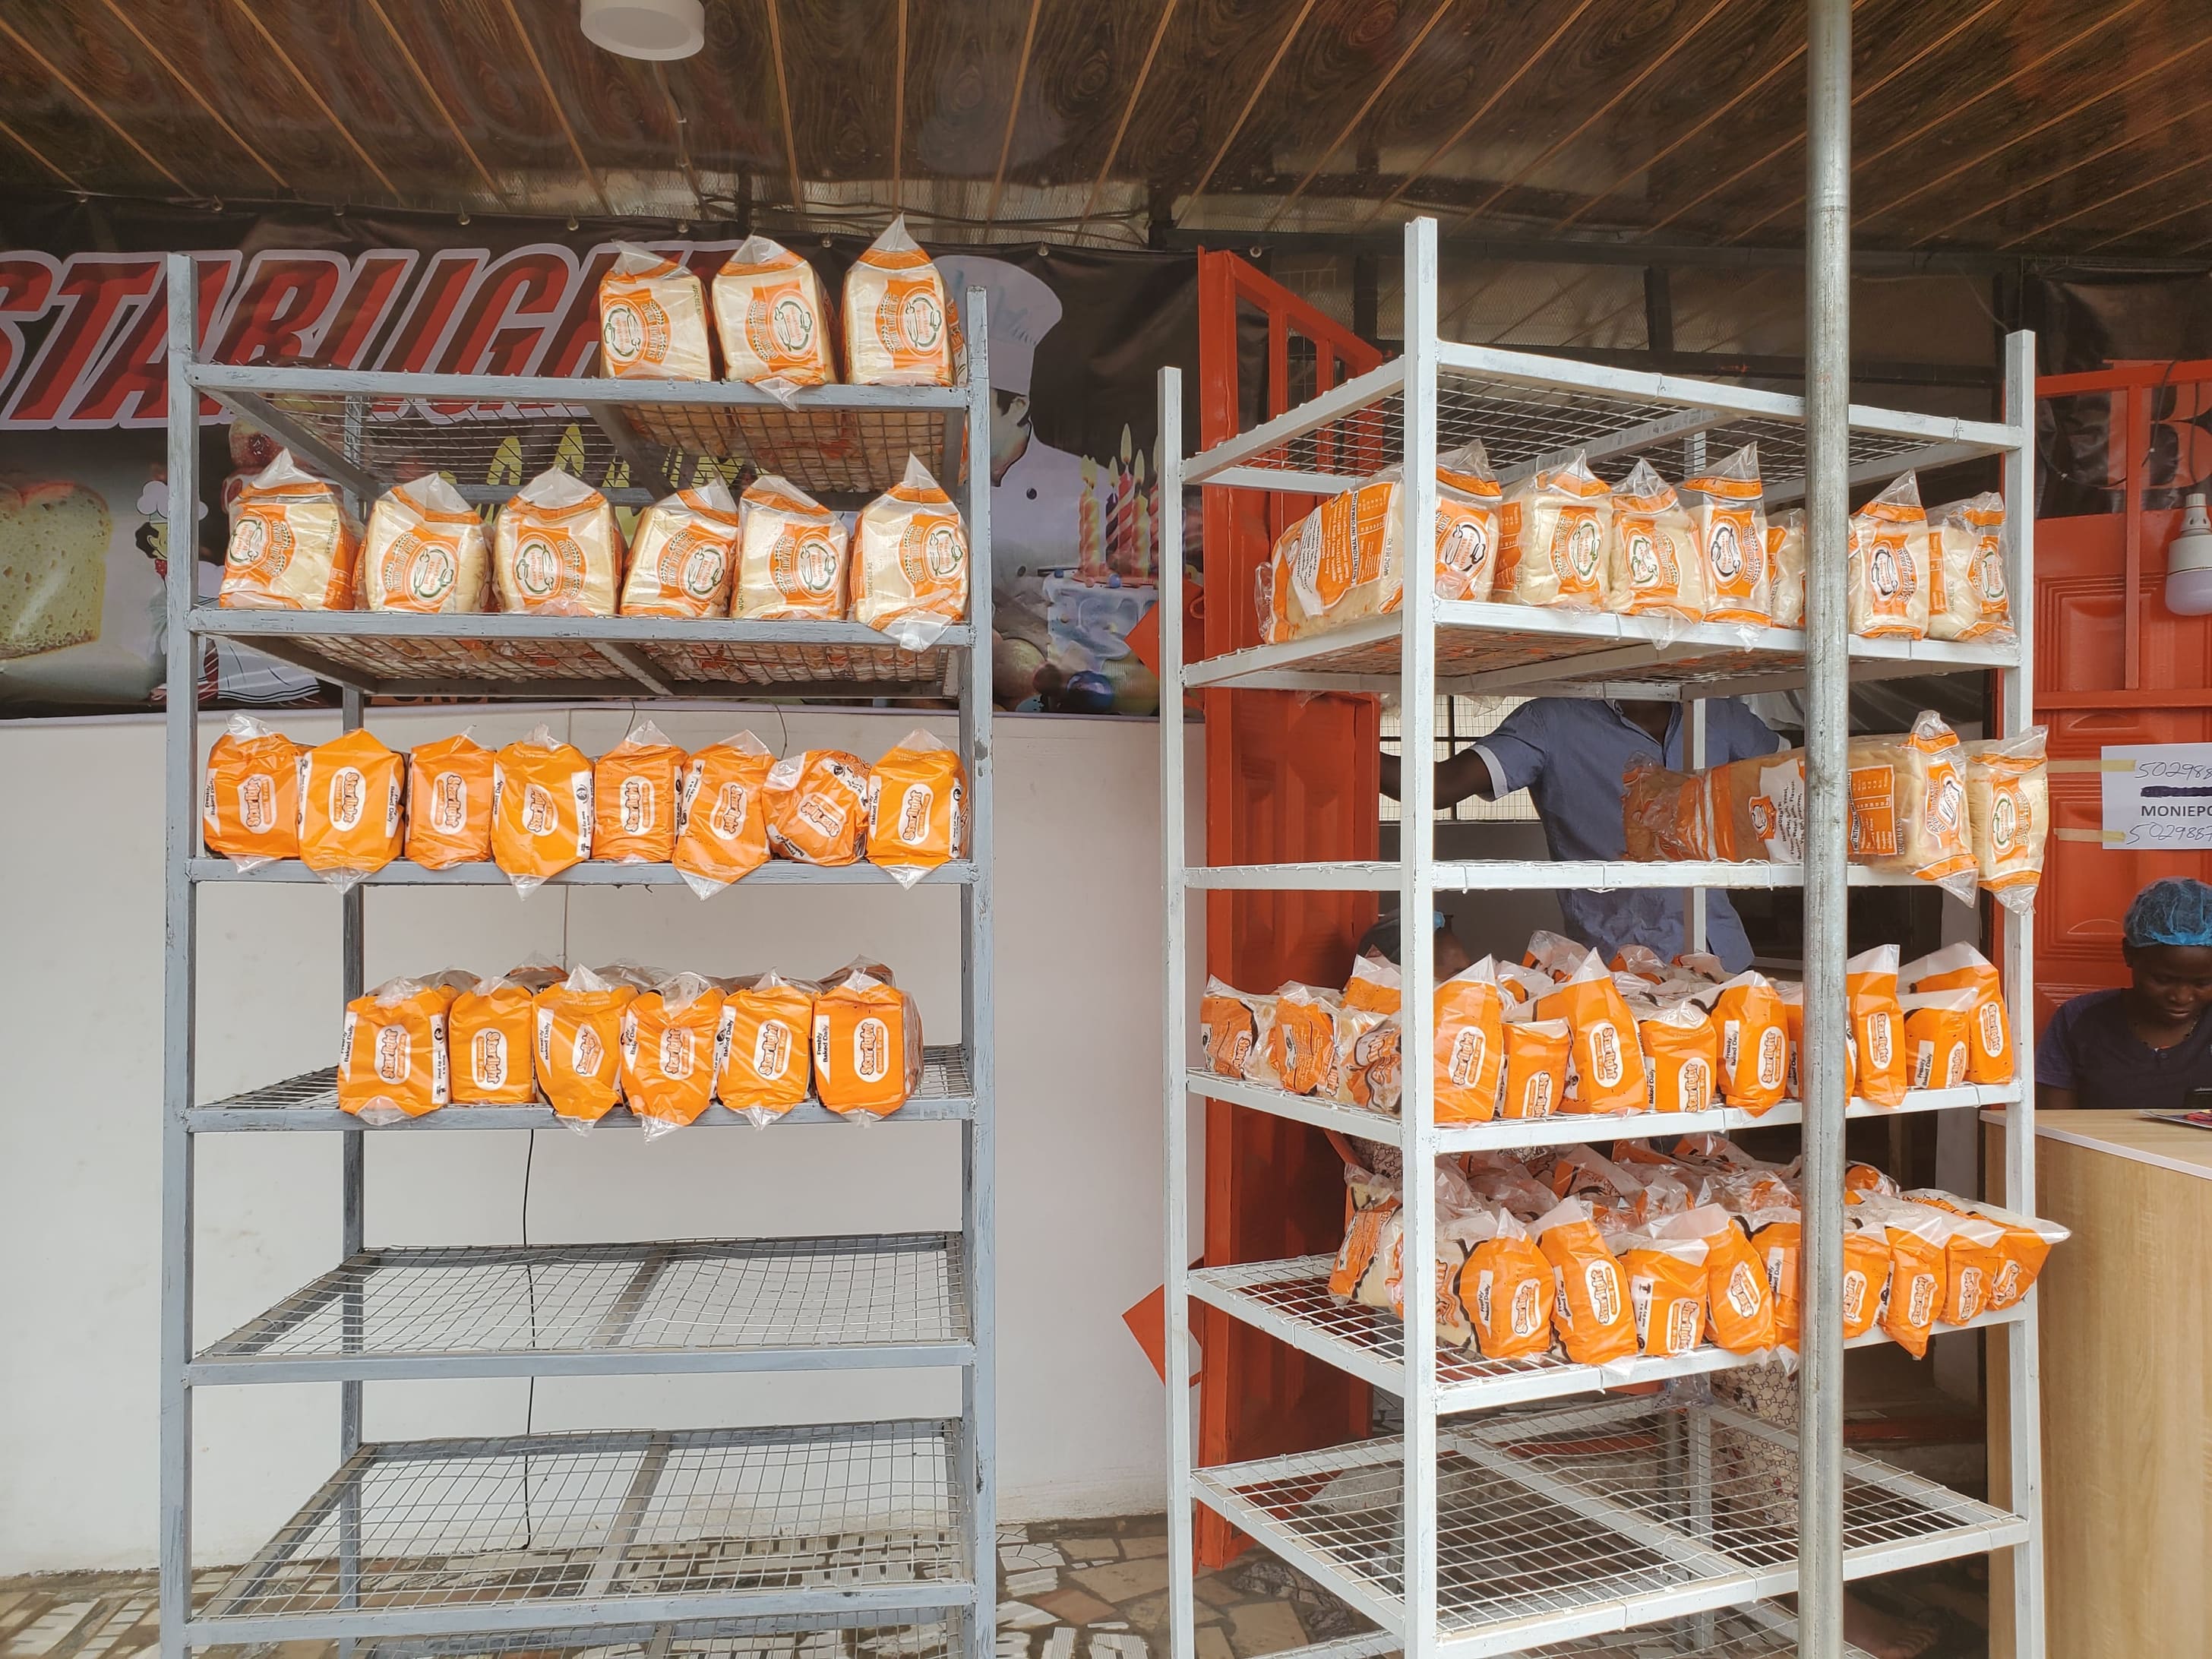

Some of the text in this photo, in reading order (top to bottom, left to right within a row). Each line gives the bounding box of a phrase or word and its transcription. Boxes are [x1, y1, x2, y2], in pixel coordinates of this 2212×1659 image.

[0, 248, 741, 427] STARLIG
[902, 790, 922, 841] Starlight
[760, 1023, 779, 1076] Starlight
[860, 1022, 876, 1075] Starlight
[1877, 1014, 1888, 1063] Starlight
[1987, 1004, 2000, 1051] Starlight
[381, 1029, 397, 1079] Starlight
[486, 1032, 501, 1084] Starlight
[1603, 1028, 1618, 1079] Starlight
[1762, 1031, 1775, 1083] Starlight
[1918, 1059, 1926, 1078] Freshly
[1685, 1063, 1700, 1112] Starlight
